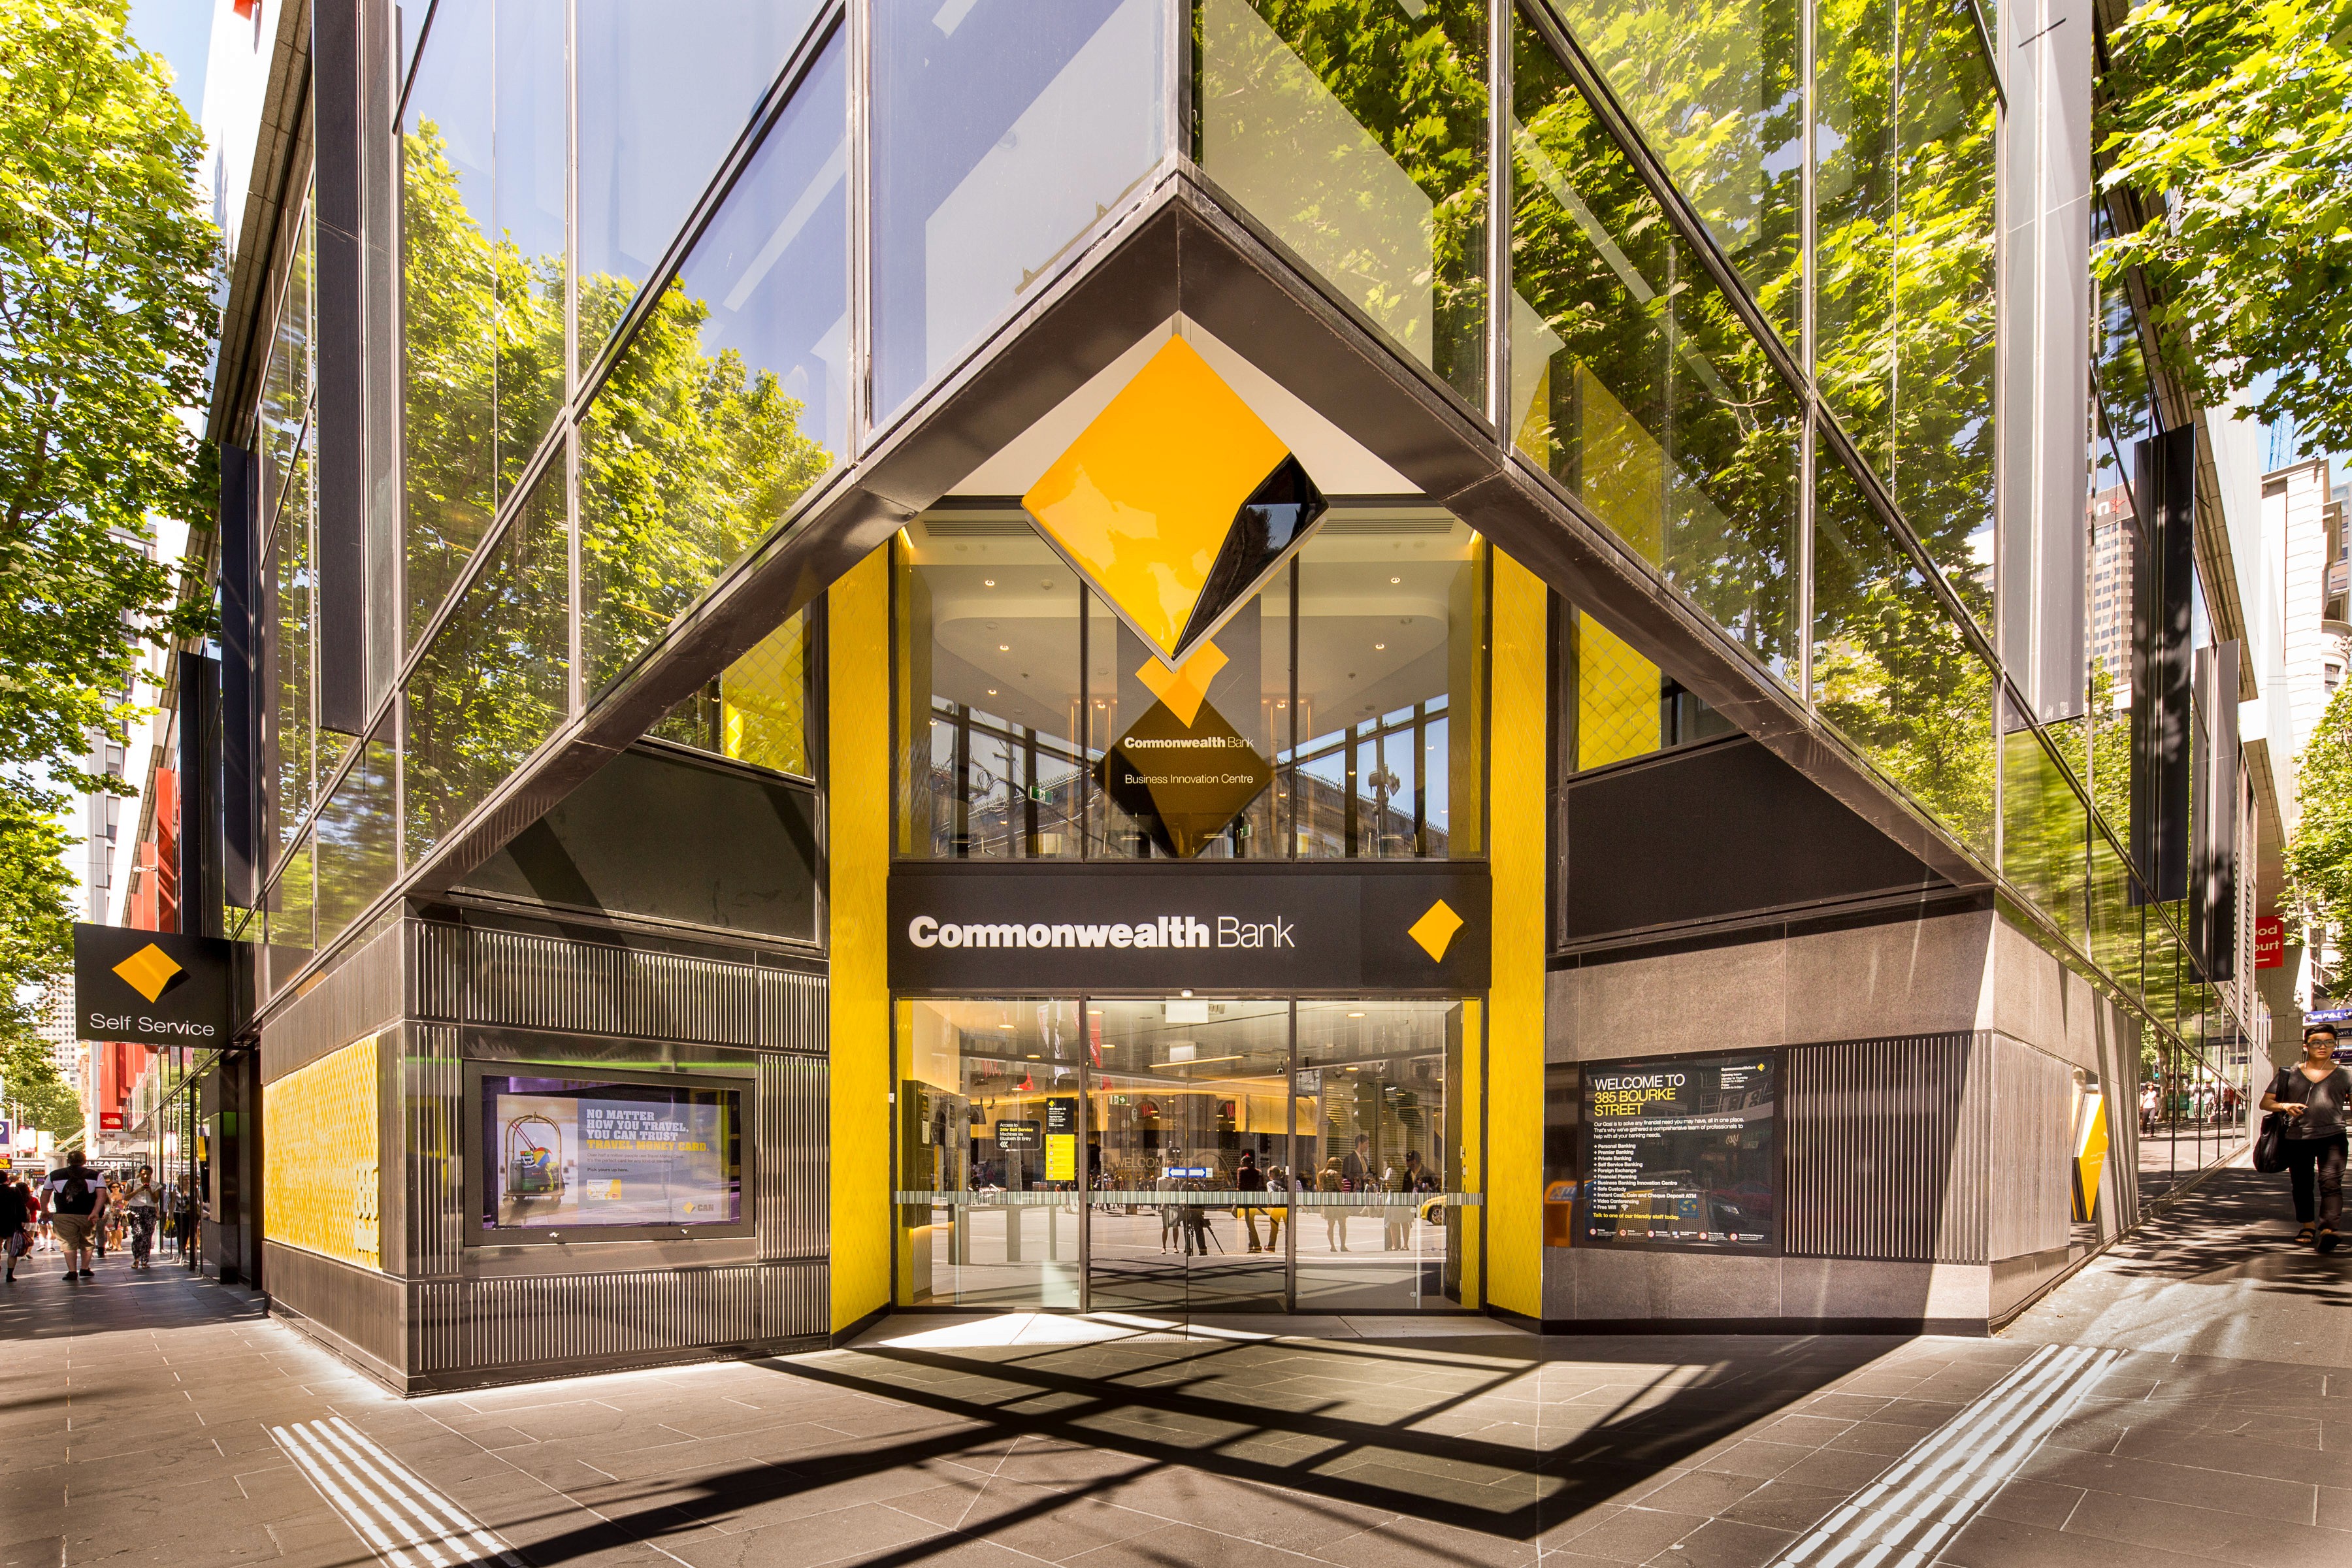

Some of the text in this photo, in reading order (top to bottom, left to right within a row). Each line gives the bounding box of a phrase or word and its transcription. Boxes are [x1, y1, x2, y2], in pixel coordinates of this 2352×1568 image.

[1124, 736, 1254, 748] Commonwealth Bank
[1125, 774, 1253, 784] Business Innovation Centre
[909, 915, 1296, 948] Commonwealth Bank
[2255, 925, 2278, 936] od
[2255, 940, 2279, 951] ourt
[90, 1013, 215, 1036] Self Service
[1595, 1073, 1686, 1090] WELCOME TO
[1594, 1088, 1676, 1103] 385 BOURKE
[587, 1109, 655, 1121] NO MATTER
[1594, 1103, 1644, 1117] STREET
[587, 1119, 689, 1133] HOW YOU TRAVEL,
[587, 1130, 678, 1141] YOU CAN TRUST
[587, 1139, 710, 1152] TRAVEL MONEY CARD.
